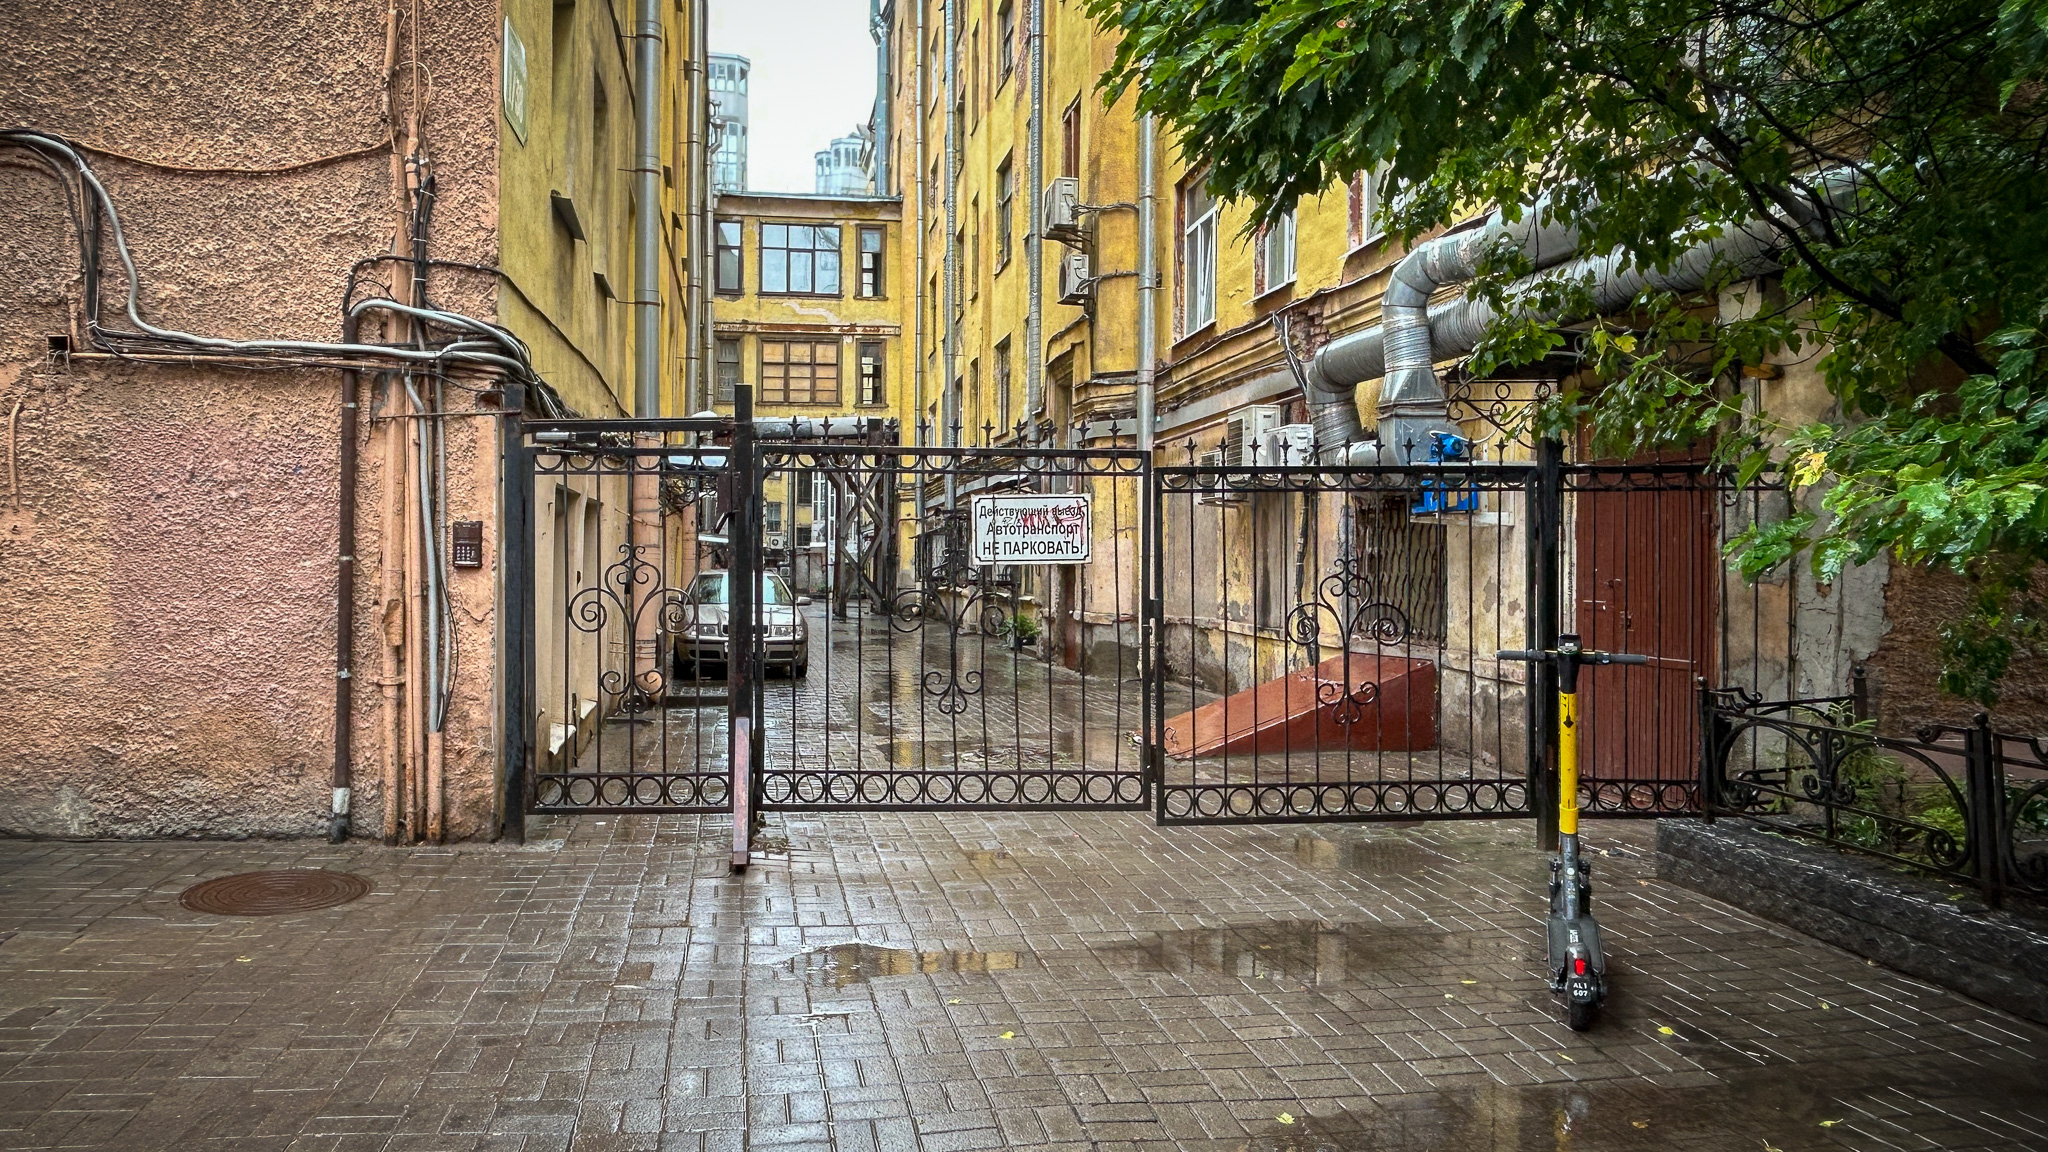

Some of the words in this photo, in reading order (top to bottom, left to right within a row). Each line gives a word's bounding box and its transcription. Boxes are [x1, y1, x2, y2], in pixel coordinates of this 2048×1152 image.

[980, 505, 1049, 519] Действующий
[986, 522, 1080, 538] Автотранспорт
[983, 541, 999, 555] НЕ
[1004, 541, 1084, 555] ПАРКОВАТЬ!
[1573, 989, 1588, 997] 607
